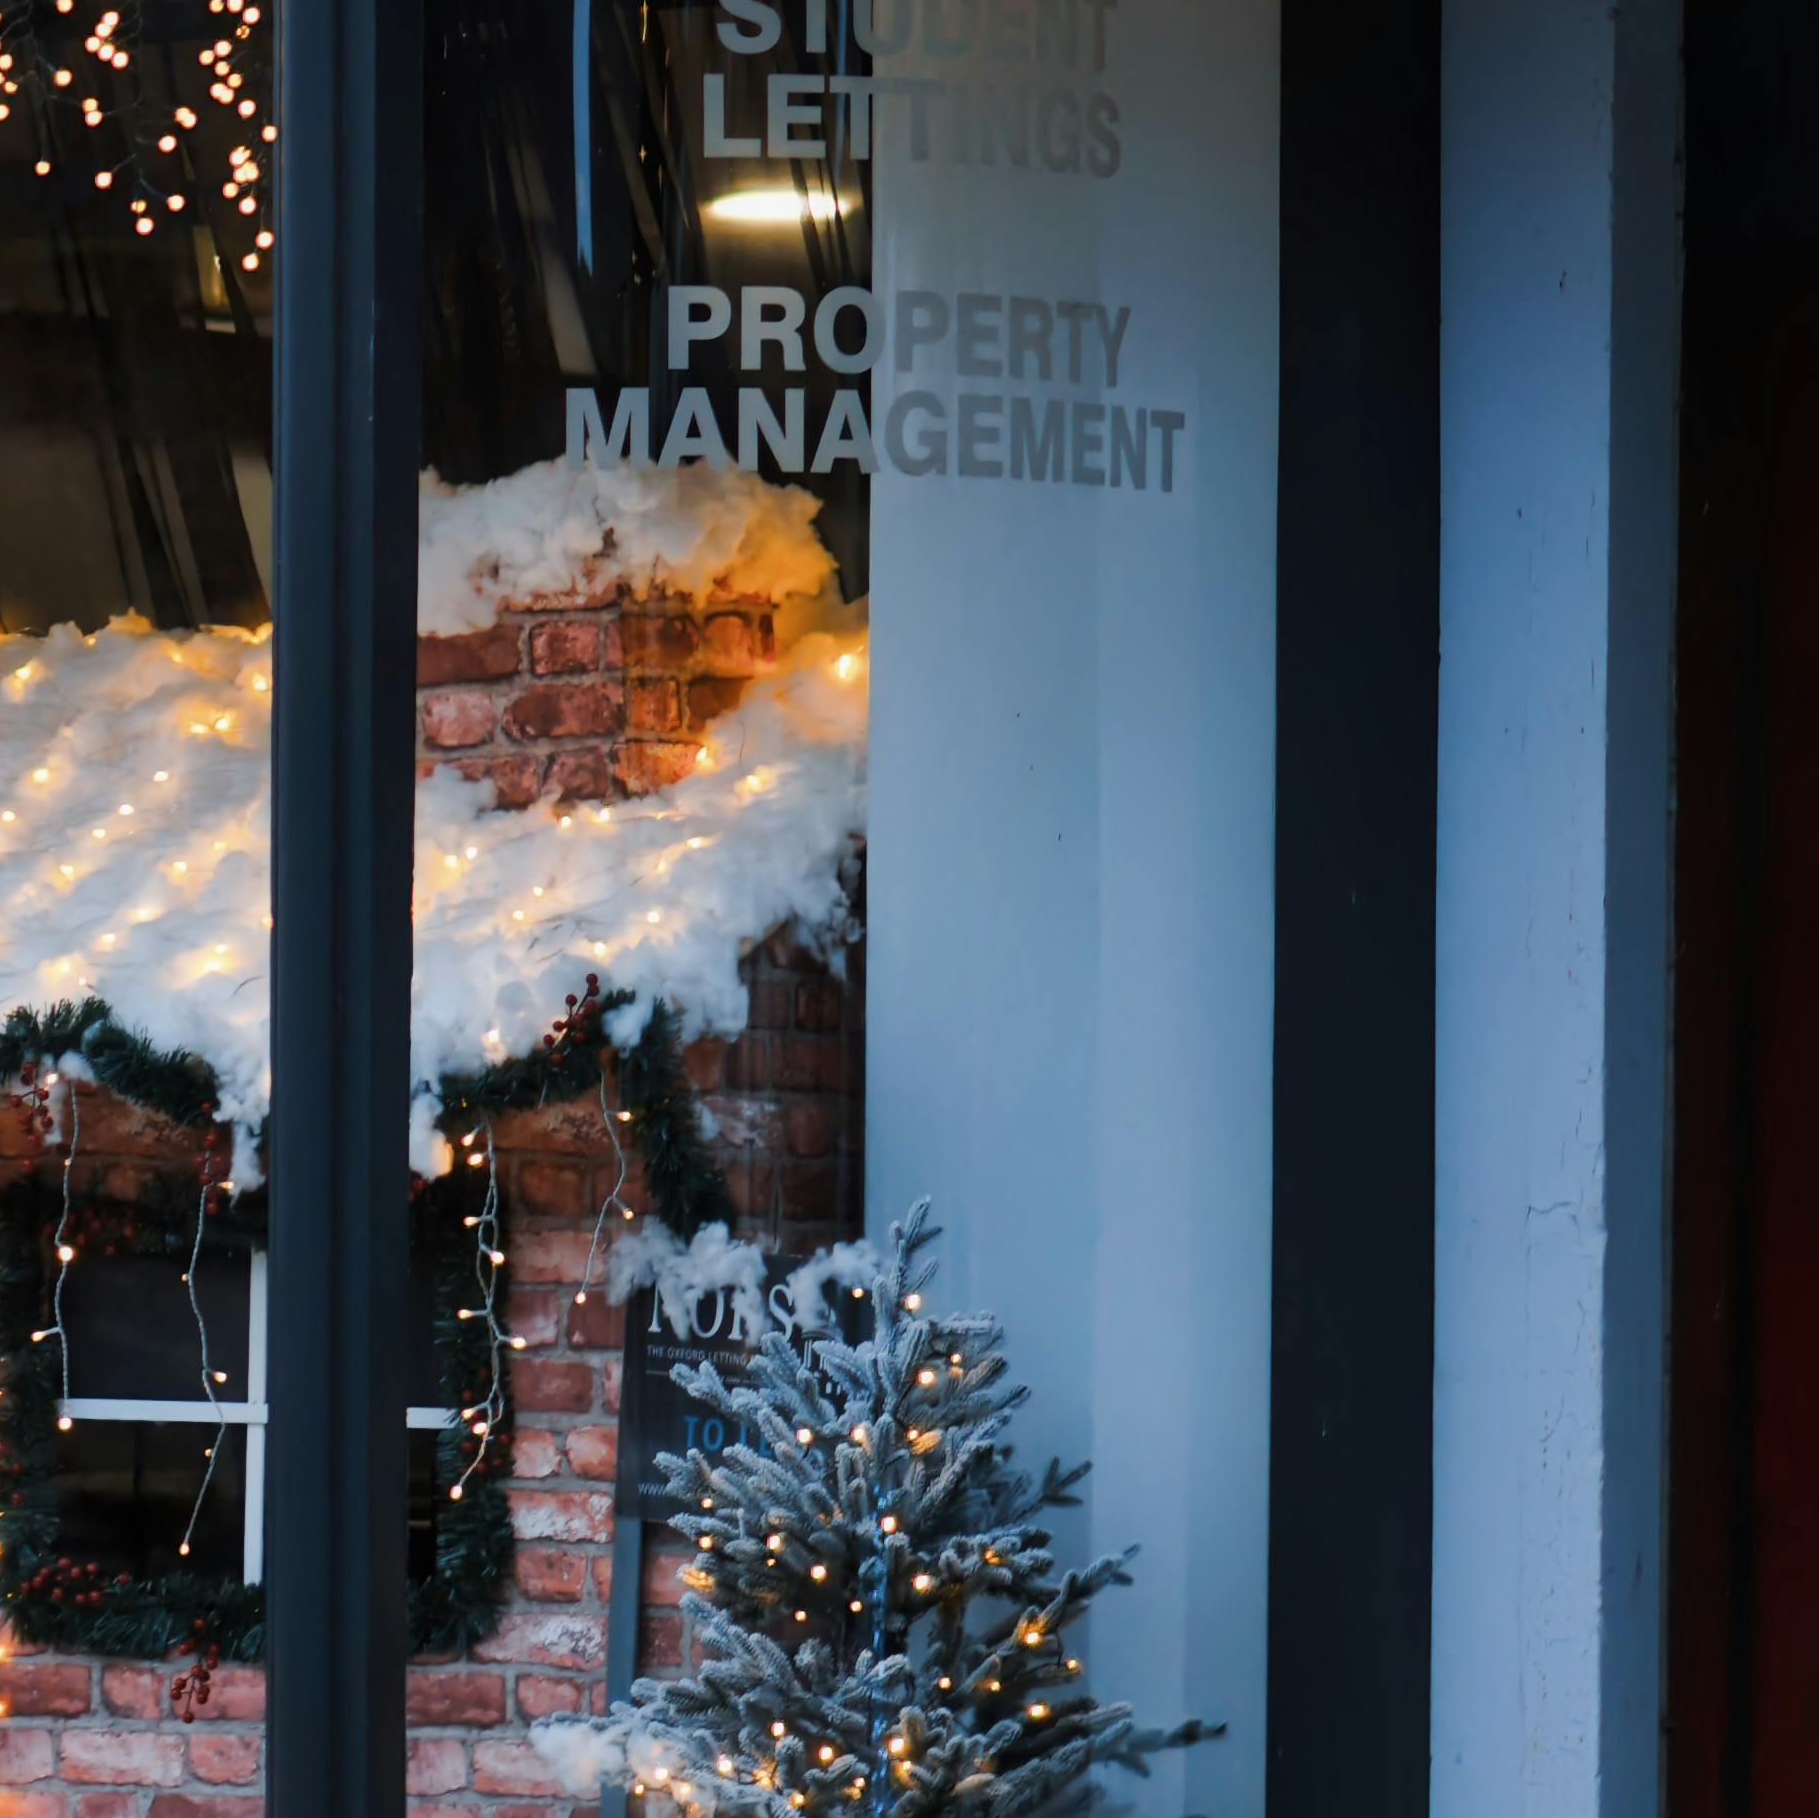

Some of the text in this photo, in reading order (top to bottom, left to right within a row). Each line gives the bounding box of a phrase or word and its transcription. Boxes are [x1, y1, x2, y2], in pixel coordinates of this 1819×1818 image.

[702, 72, 1123, 180] LETTINGS
[666, 284, 1132, 389] PROPERTY
[564, 386, 1186, 494] MANAGEMENT
[646, 1345, 664, 1359] THE
